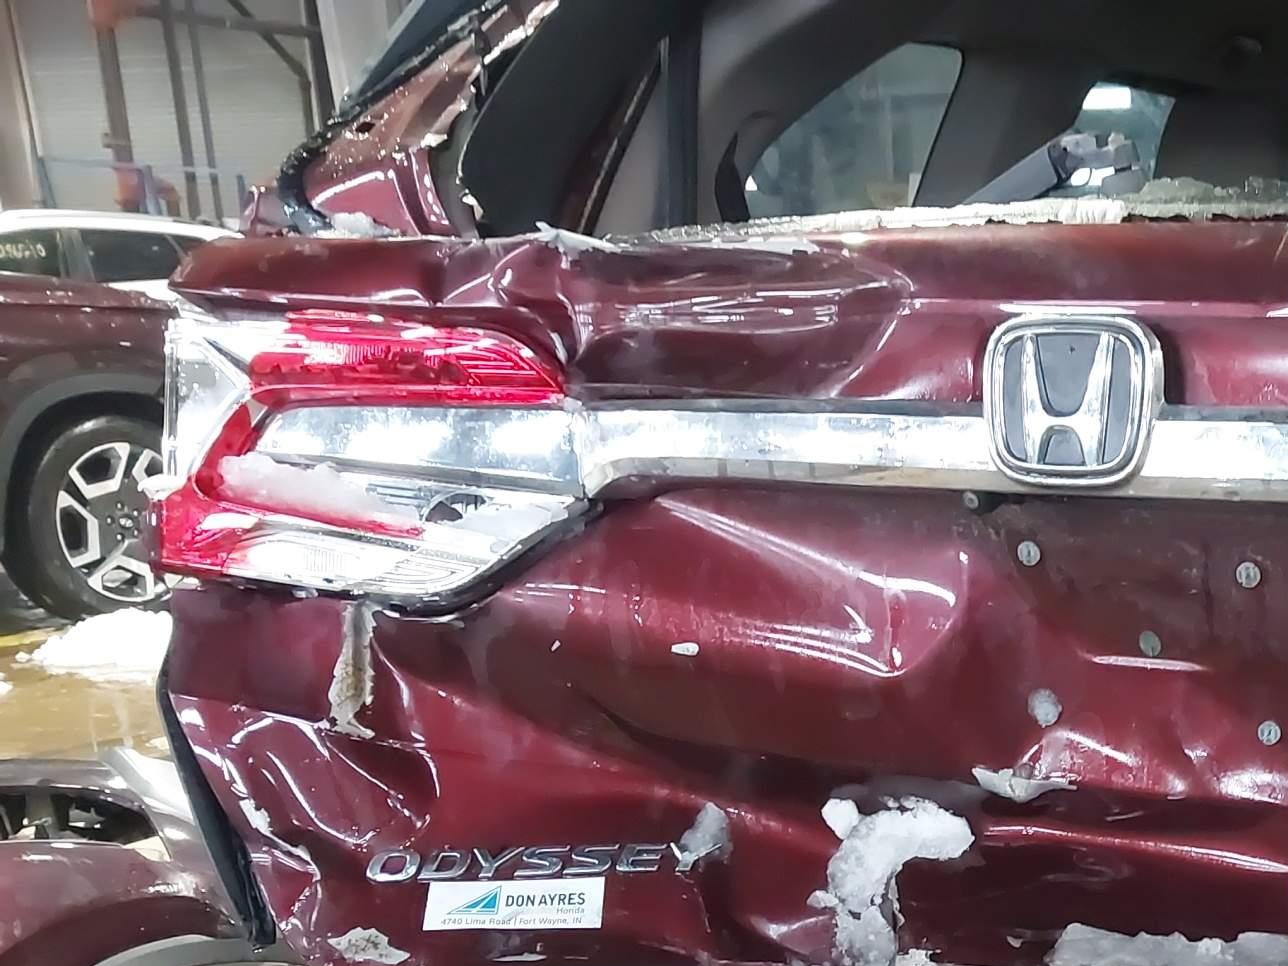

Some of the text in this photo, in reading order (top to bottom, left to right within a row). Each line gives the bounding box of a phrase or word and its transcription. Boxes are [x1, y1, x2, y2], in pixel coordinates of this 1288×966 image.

[365, 841, 722, 884] ODYSSEY
[505, 892, 586, 907] DON AYRES
[440, 917, 463, 926] 4740
[465, 917, 486, 925] Lima
[488, 917, 512, 926] Road
[519, 917, 537, 926] Fort
[572, 916, 582, 924] IN
